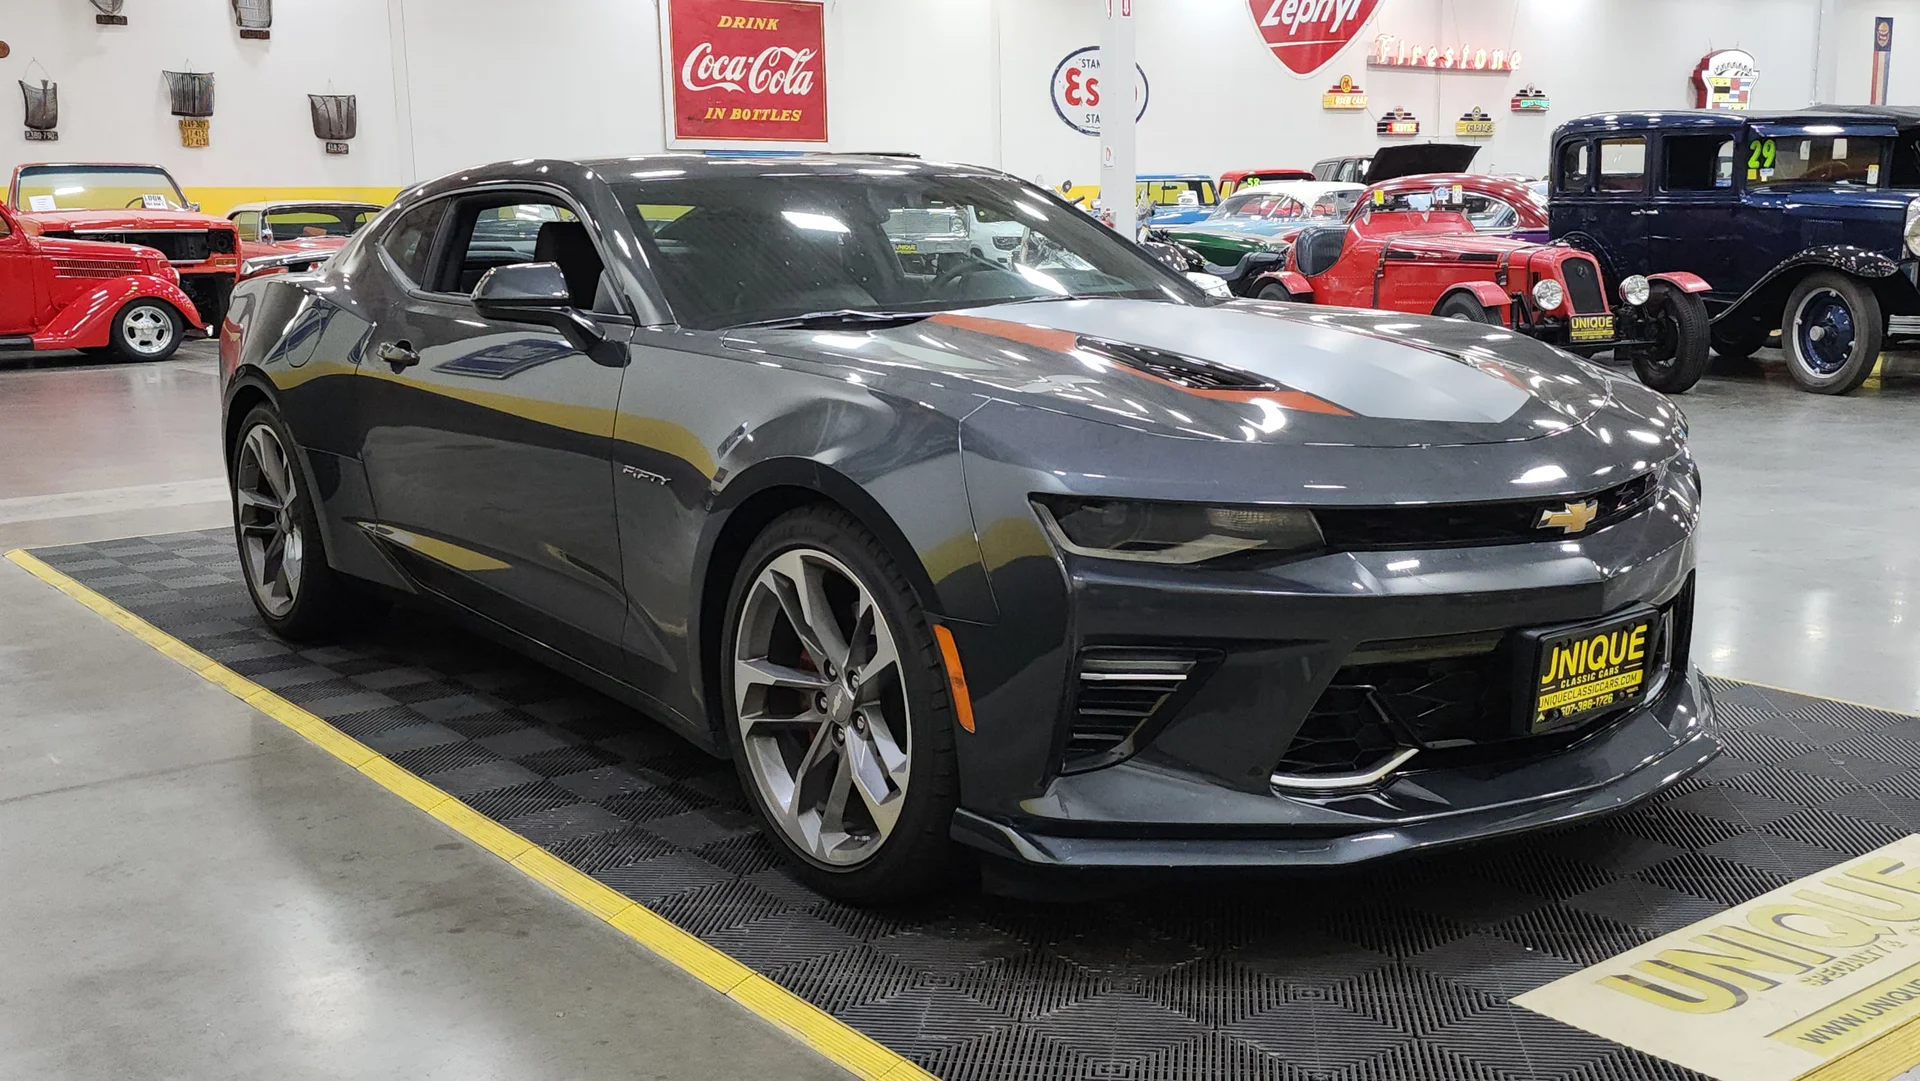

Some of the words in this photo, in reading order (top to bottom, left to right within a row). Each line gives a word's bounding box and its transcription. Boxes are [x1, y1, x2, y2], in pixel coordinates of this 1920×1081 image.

[717, 15, 780, 31] DRINK
[1375, 33, 1523, 71] Firestone
[681, 42, 818, 96] Coca-Cola
[704, 107, 727, 121] IN
[729, 108, 802, 122] BOTTLES
[1747, 139, 1776, 168] 29
[1571, 316, 1613, 329] UNIQUE
[622, 464, 672, 486] FIFTY
[1560, 672, 1596, 689] CLASSIC
[1598, 665, 1620, 679] CARS
